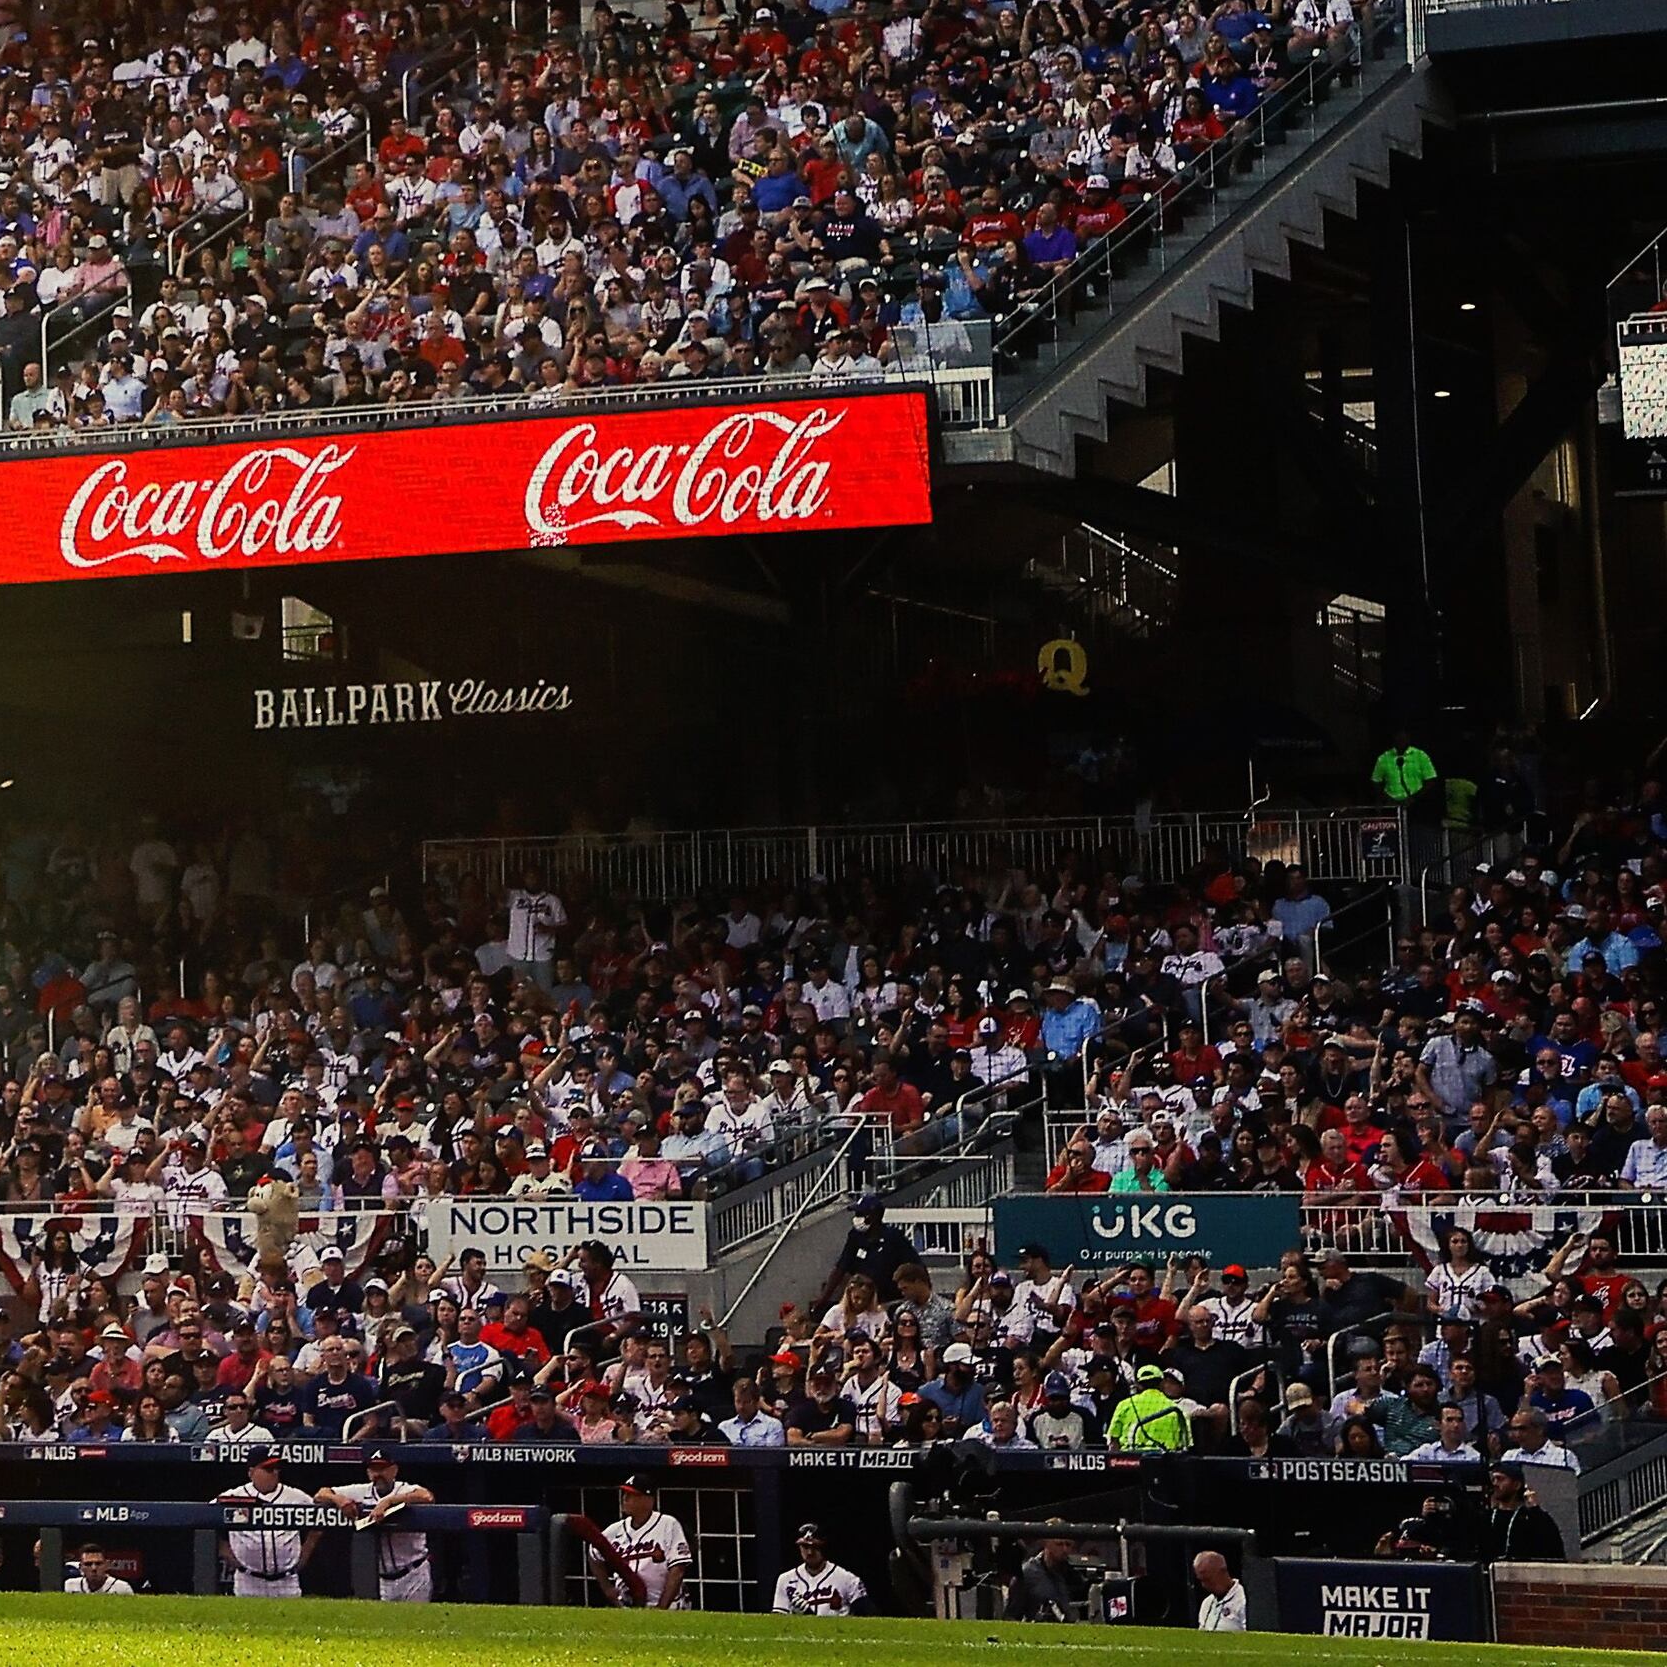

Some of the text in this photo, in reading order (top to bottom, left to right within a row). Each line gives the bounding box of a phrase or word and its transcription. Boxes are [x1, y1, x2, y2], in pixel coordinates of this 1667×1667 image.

[1038, 639, 1090, 696] Q
[253, 678, 573, 729] BALLPARK Classics
[450, 1205, 695, 1236] NORTHSIDE
[1091, 1202, 1197, 1239] UKG
[494, 1244, 650, 1265] HOSAL
[1157, 1247, 1168, 1260] is
[43, 1446, 76, 1461] NLDS
[219, 1444, 325, 1463] POSEASON
[472, 1447, 577, 1463] MLB NETWORK
[789, 1451, 914, 1468] MAKE IT MAJO
[1069, 1454, 1105, 1470] NLDS
[1282, 1461, 1408, 1483] POSTSEASON
[96, 1507, 150, 1522] MLB App
[251, 1506, 354, 1527] POSTSEASO
[1321, 1585, 1431, 1610] MAKE IT
[1328, 1613, 1427, 1639] MAJOR
